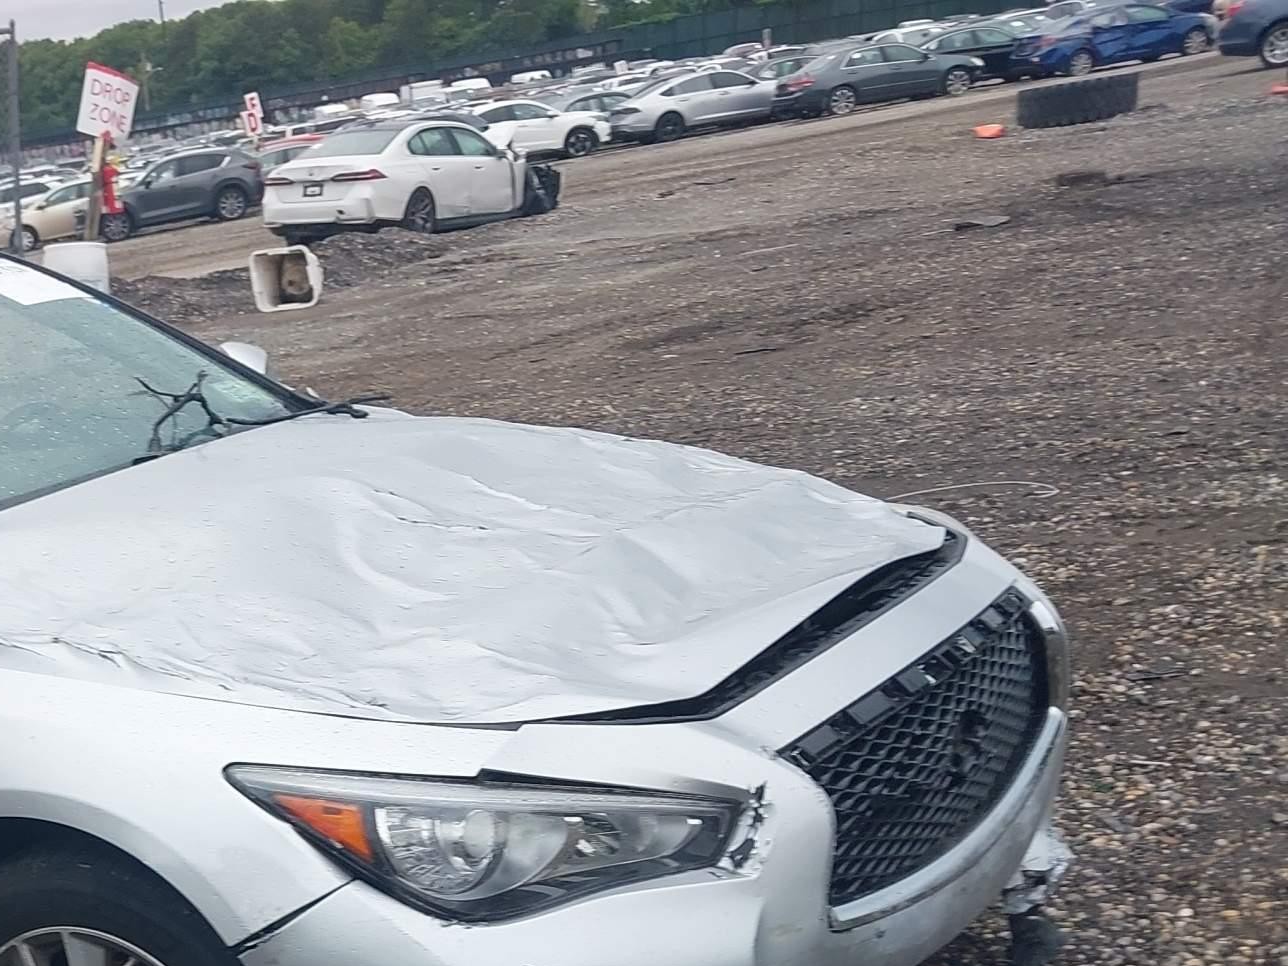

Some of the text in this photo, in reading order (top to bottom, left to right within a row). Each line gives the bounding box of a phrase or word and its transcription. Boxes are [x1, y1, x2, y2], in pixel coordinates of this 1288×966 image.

[90, 78, 130, 107] DROP
[88, 103, 127, 134] ZONE
[248, 112, 258, 133] D
